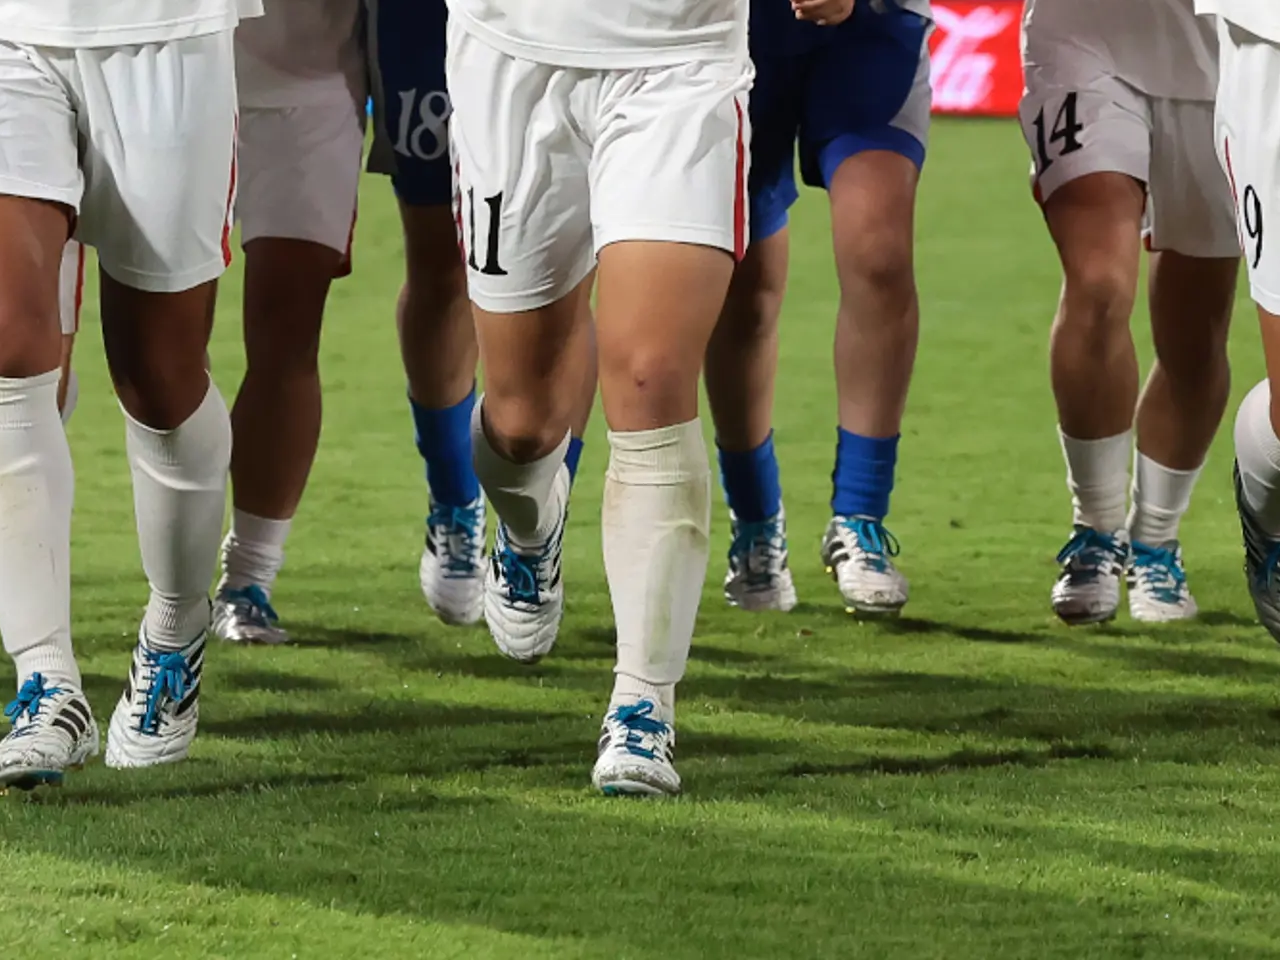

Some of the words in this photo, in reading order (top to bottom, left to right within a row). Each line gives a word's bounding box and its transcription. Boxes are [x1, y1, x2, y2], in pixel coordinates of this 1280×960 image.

[393, 88, 451, 160] 18
[1032, 91, 1083, 177] 14
[467, 186, 508, 275] 11
[1244, 183, 1264, 270] 9
